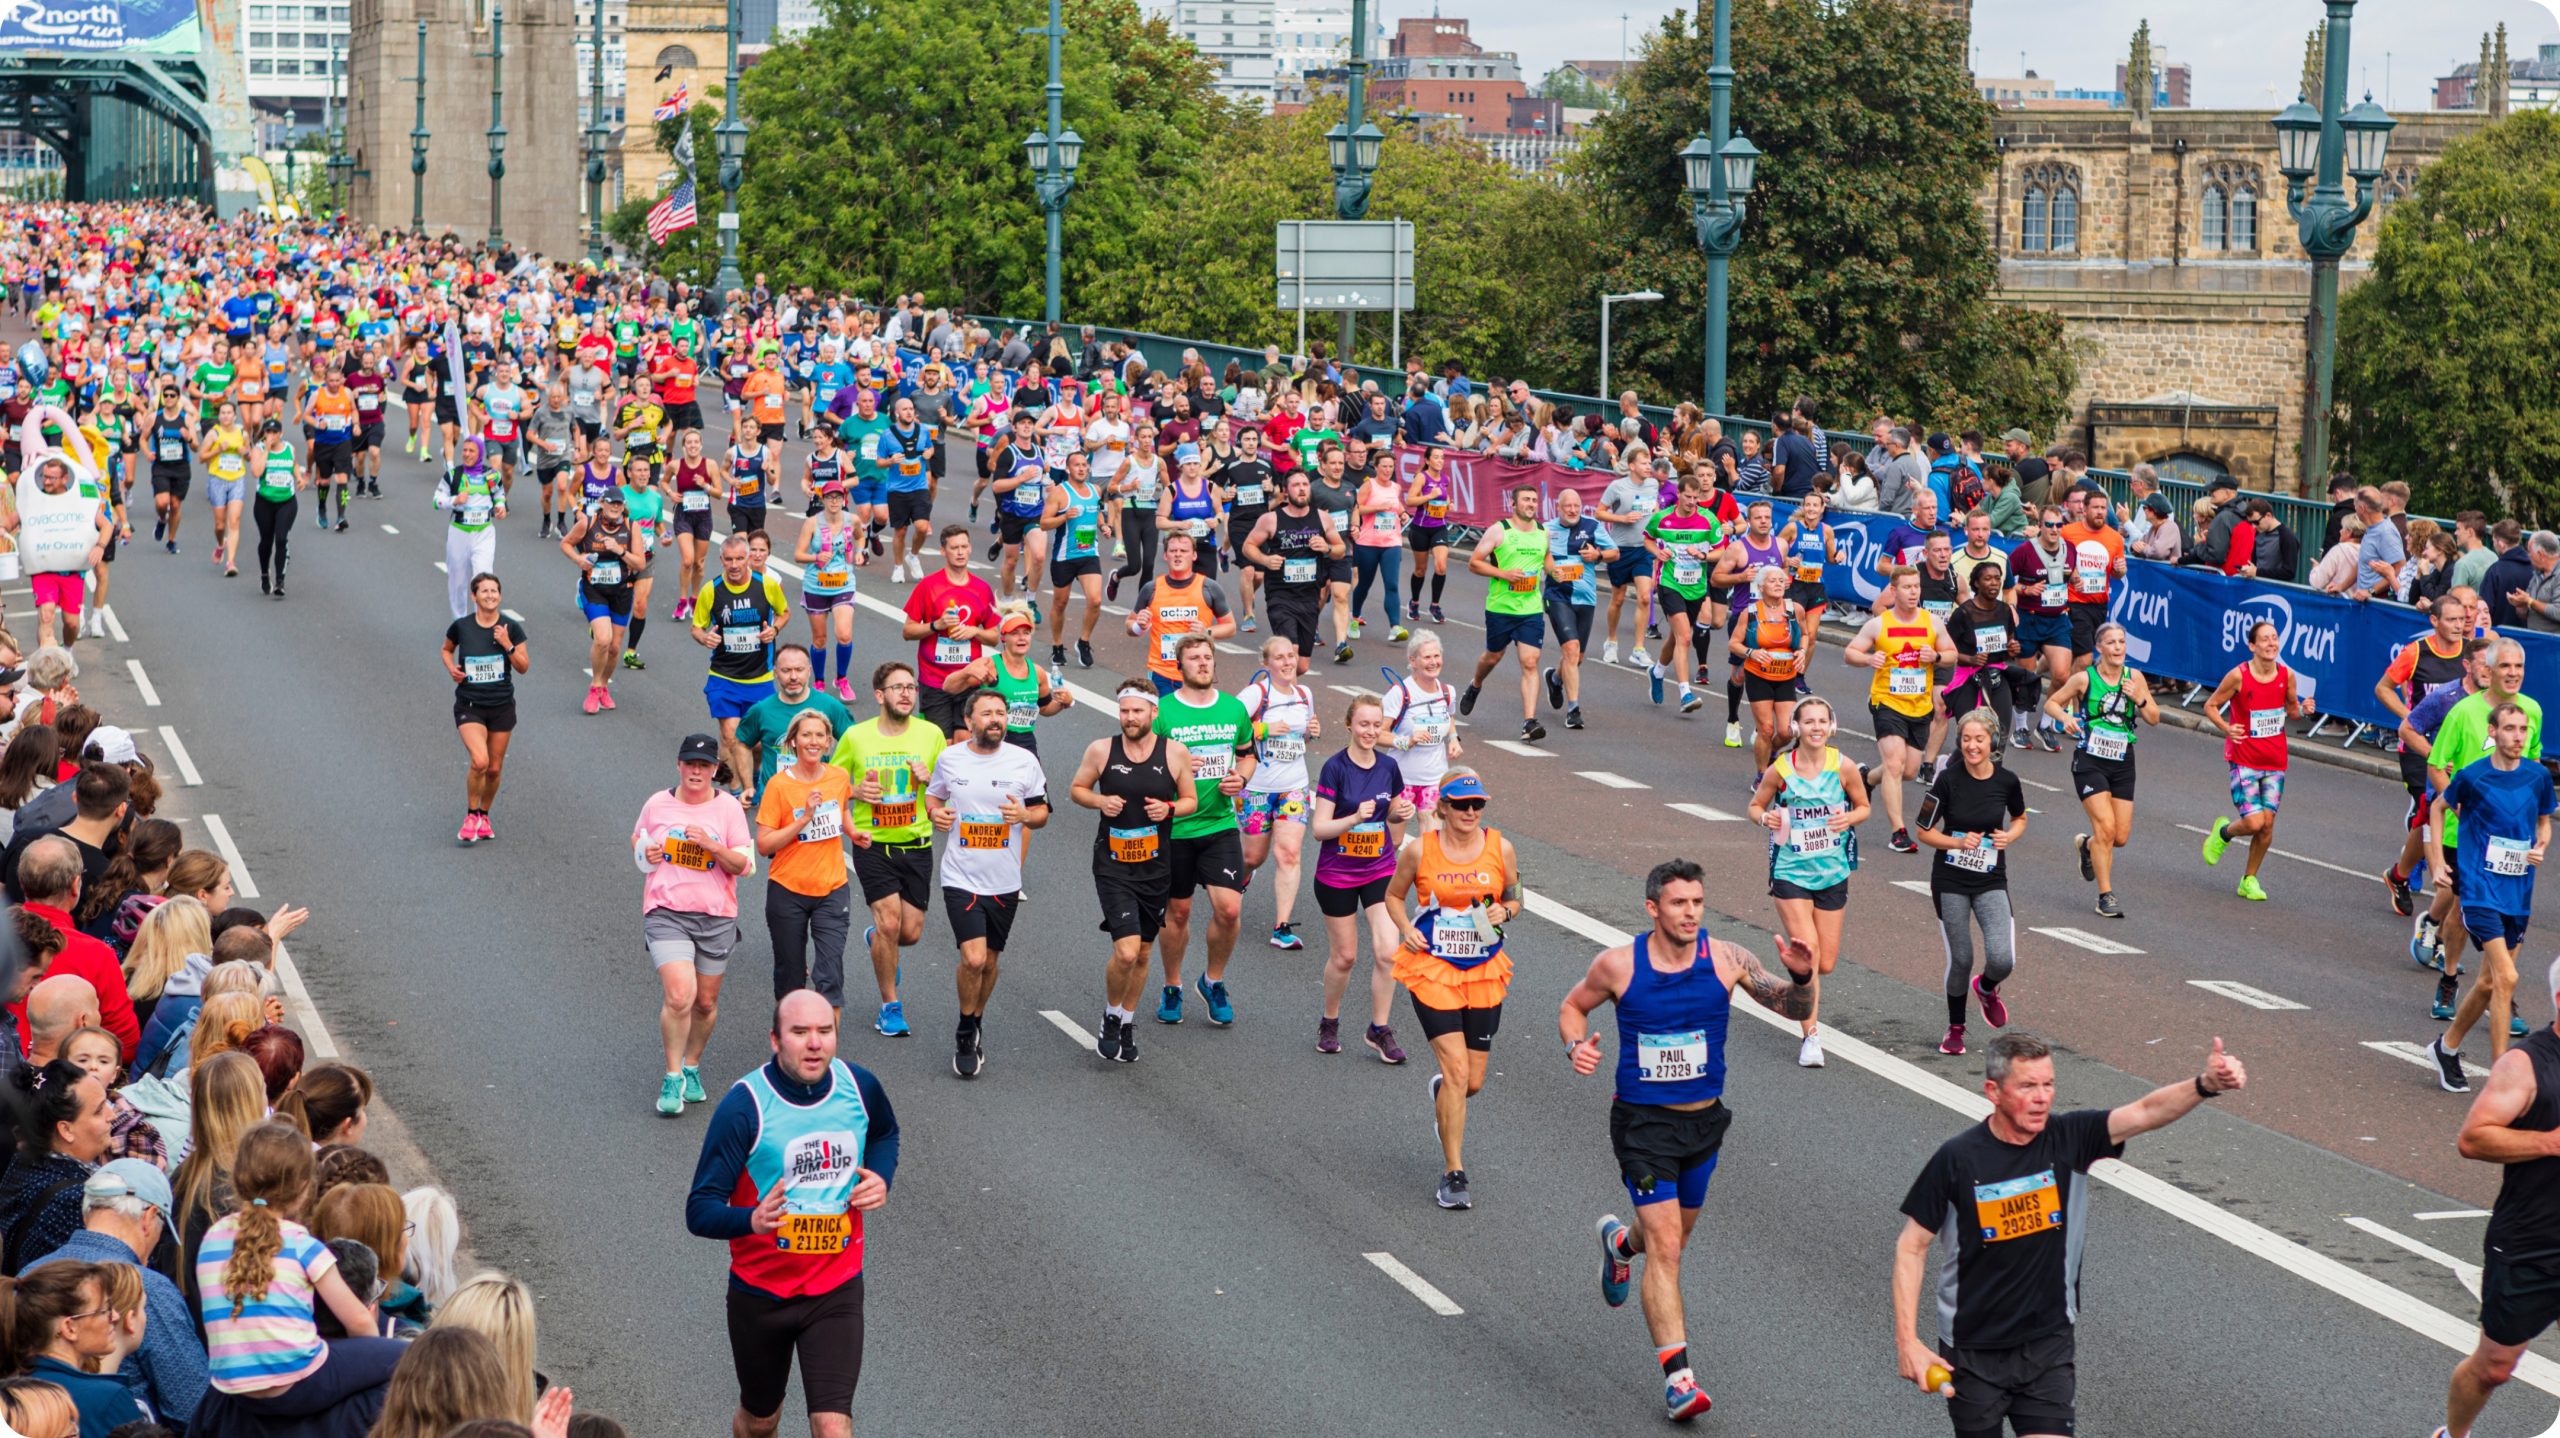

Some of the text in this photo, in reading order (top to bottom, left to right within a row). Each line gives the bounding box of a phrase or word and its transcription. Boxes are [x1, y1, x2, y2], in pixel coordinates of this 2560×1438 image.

[46, 5, 119, 24] north
[80, 24, 124, 38] run
[2080, 559, 2104, 569] now
[733, 598, 752, 609] IAN
[2127, 589, 2171, 629] run
[1160, 608, 1198, 617] action
[1984, 634, 2001, 644] JANICE
[2291, 621, 2337, 663] run
[476, 664, 494, 672] HAZEL
[2256, 716, 2281, 729] SUZANNE
[1170, 723, 1238, 738] MACMILLAN
[1203, 732, 1236, 742] SUPPORT
[2259, 725, 2278, 736] 27254
[1268, 738, 1306, 752] SARAH-JAYNE
[2096, 743, 2119, 756] 26114
[874, 804, 915, 816] ALEXANDER
[1795, 806, 1831, 820] EMMA
[811, 814, 831, 828] KATY
[810, 824, 838, 840] 27410
[967, 824, 1003, 837] ANDREW
[1803, 828, 1828, 841] EMMA
[971, 837, 999, 848] 17202
[1346, 833, 1380, 845] ELEANOR
[1804, 838, 1830, 851] 30887
[676, 842, 706, 857] LOUISE
[1121, 848, 1147, 861] 18694
[1352, 844, 1374, 855] 4240
[675, 852, 704, 868] 19605
[1957, 855, 1985, 870] 25442
[2504, 850, 2522, 863] PHIL
[1436, 870, 1490, 886] mnda
[1446, 943, 1476, 956] 21867
[1659, 1049, 1686, 1063] PAUL
[1656, 1061, 1692, 1078] 27329
[804, 1142, 822, 1152] THE
[799, 1169, 841, 1184] CHARITY
[1999, 1194, 2041, 1218] JAMES
[792, 1216, 843, 1235] PATRICK
[2002, 1212, 2044, 1237] 29236
[796, 1235, 838, 1252] 21152
